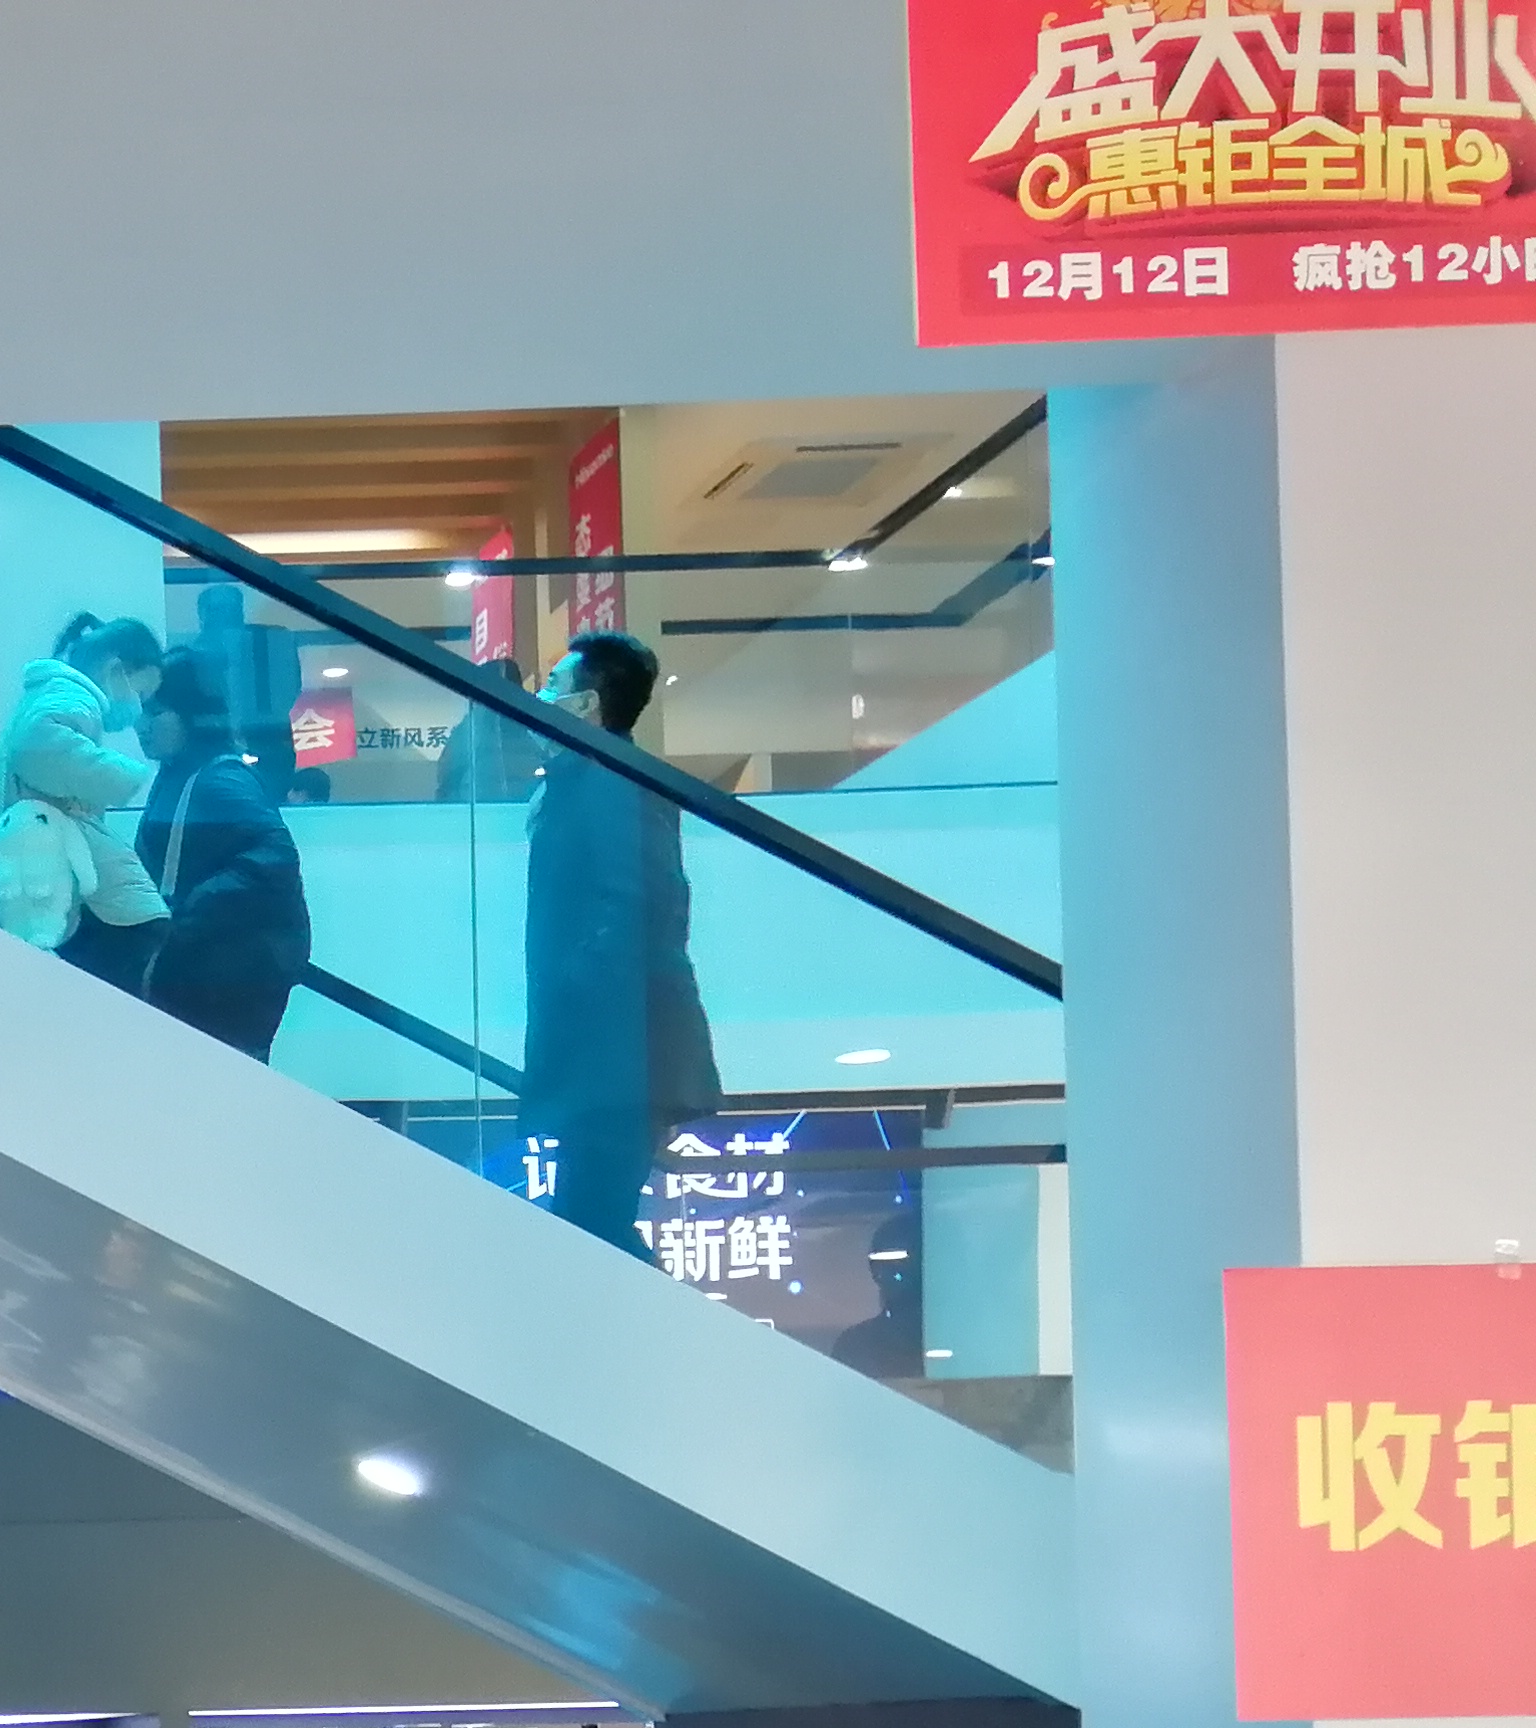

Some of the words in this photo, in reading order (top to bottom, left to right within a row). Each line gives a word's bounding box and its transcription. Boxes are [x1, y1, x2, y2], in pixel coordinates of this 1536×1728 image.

[1019, 114, 1510, 221] 惠钜全城
[987, 246, 1228, 302] 12月12日
[1292, 236, 1536, 292] 疯抢12小
